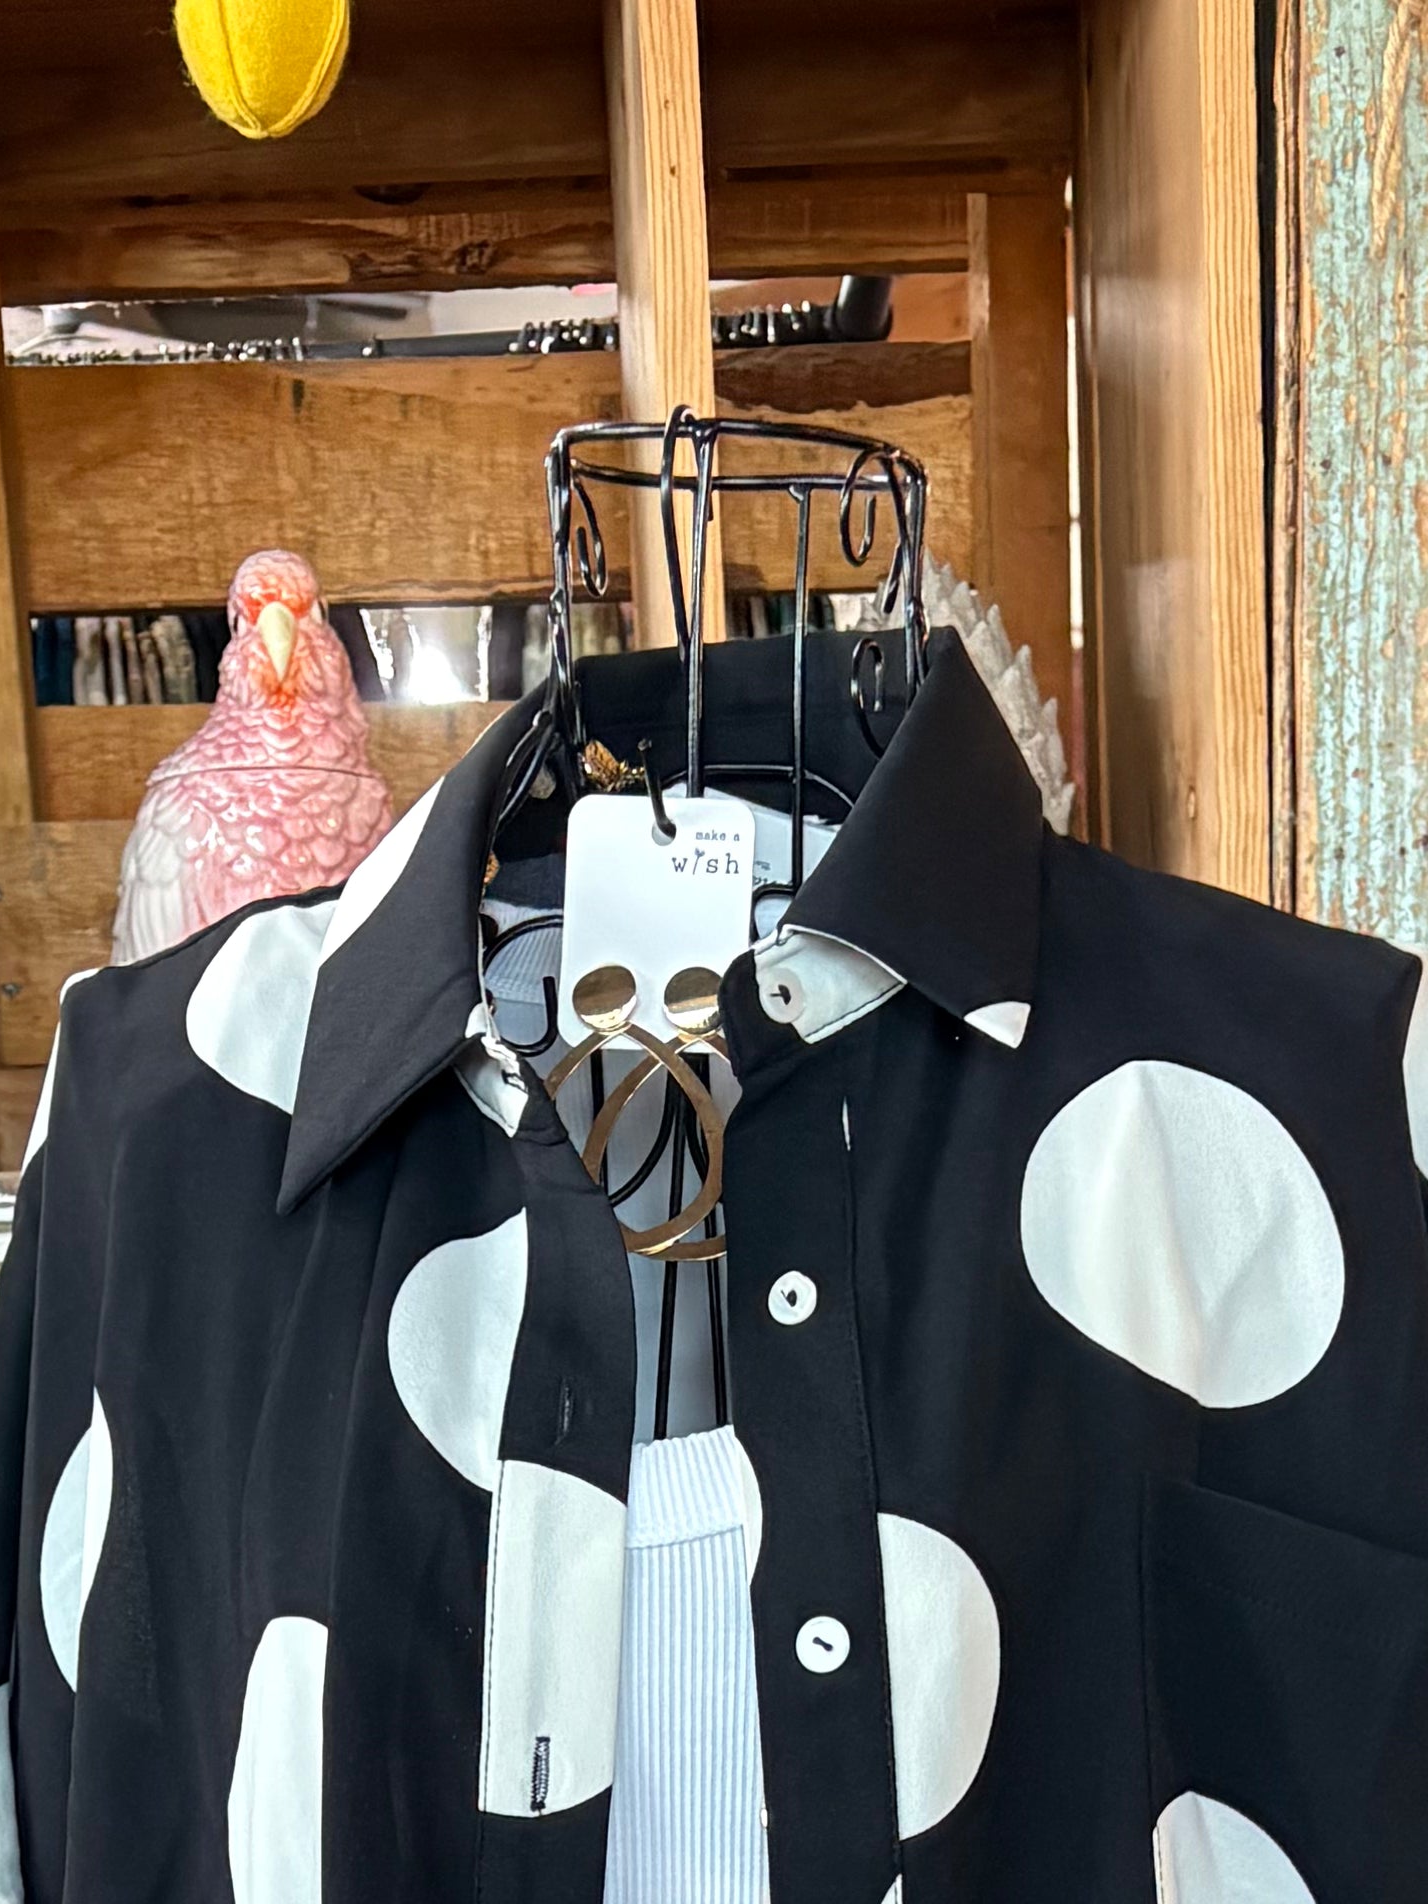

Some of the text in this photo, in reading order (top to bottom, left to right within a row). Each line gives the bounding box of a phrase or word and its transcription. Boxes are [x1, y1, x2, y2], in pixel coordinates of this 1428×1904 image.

[695, 829, 741, 842] make a
[671, 847, 740, 876] wish
